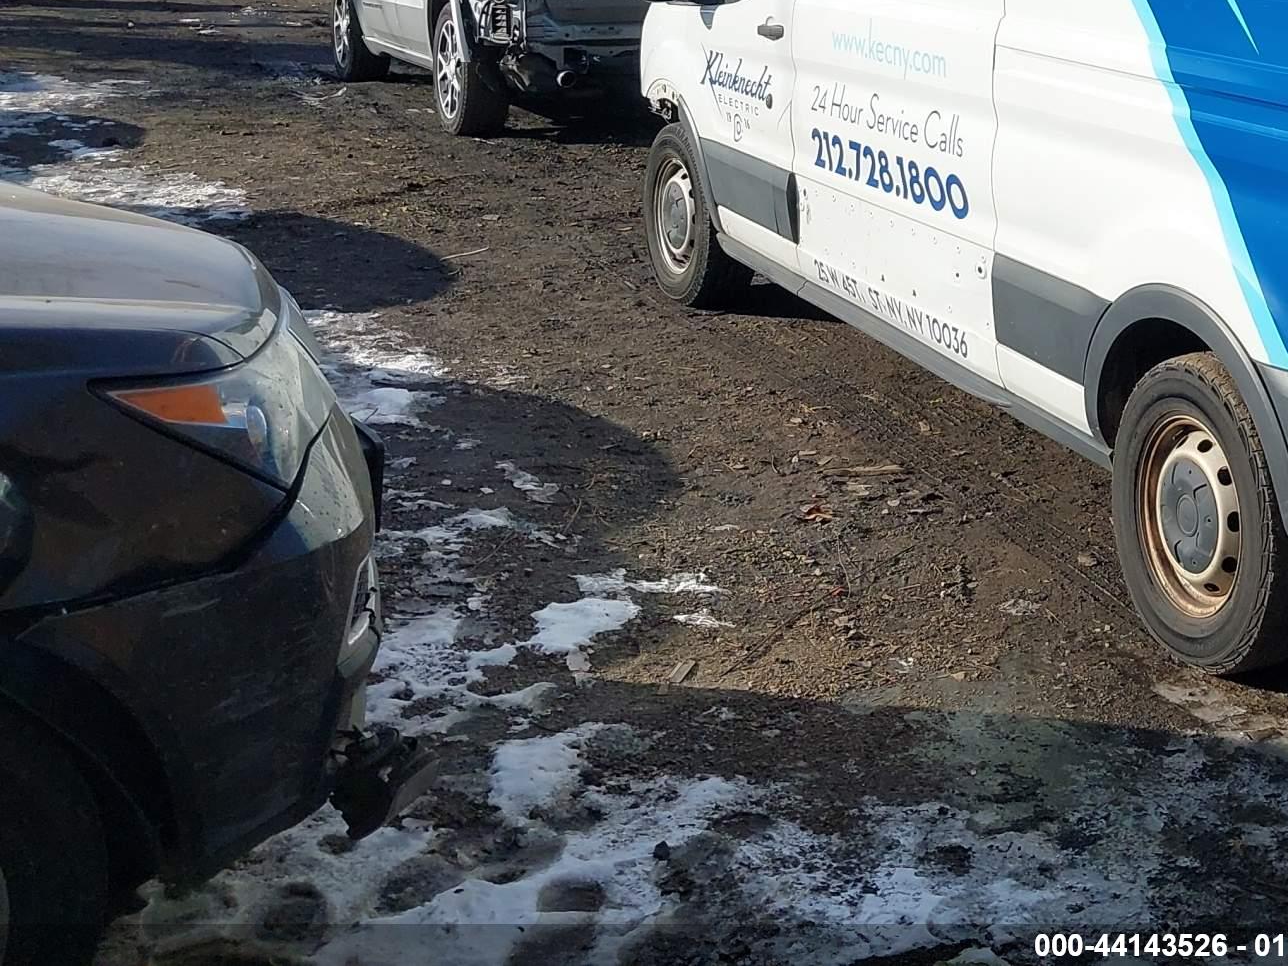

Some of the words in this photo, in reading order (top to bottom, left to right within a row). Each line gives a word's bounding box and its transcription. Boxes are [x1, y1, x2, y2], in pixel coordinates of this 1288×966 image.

[700, 50, 772, 102] Kleinknecht
[832, 19, 946, 79] www.kecny.com
[719, 94, 759, 116] ELECTRIC
[811, 85, 828, 113] 24
[830, 82, 864, 126] Hour
[866, 92, 919, 144] Service
[924, 110, 964, 158] Calls
[811, 128, 970, 220] 212.728.1800
[814, 259, 829, 283] 25
[827, 265, 843, 289] W
[926, 314, 968, 359] 10036
